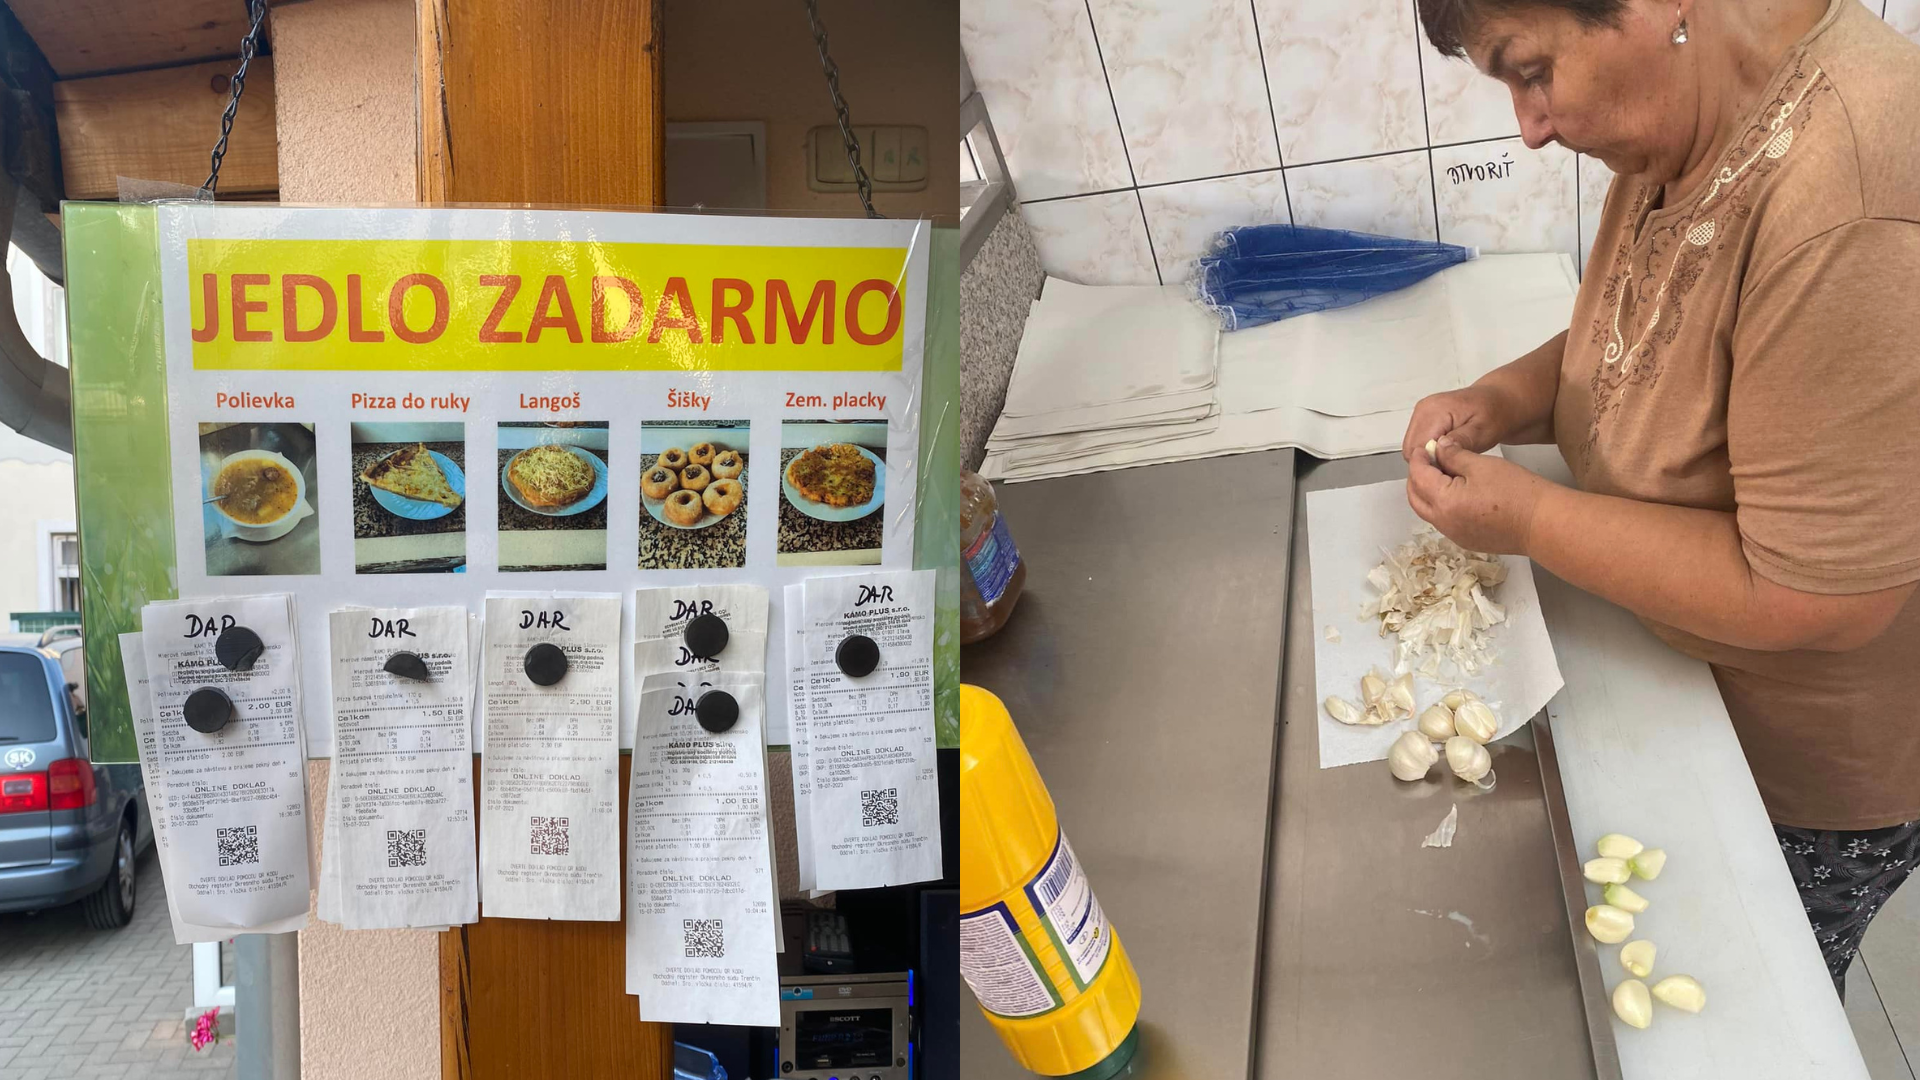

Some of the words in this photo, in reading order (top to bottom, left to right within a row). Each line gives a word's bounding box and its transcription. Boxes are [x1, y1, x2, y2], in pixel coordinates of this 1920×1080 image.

[191, 273, 451, 344] JEDLO
[478, 274, 902, 346] ZADARMO
[216, 391, 295, 410] Polievka
[352, 392, 396, 410] Pizza
[401, 392, 426, 410] do
[430, 392, 470, 413] ruky
[519, 391, 580, 413] Langoš
[666, 389, 711, 413] Šišky
[785, 392, 827, 408] Zem.
[832, 392, 886, 413] placky
[855, 585, 893, 607] DAR
[670, 599, 713, 621] DAR
[184, 614, 236, 637] DAR
[368, 618, 416, 638] DAR
[668, 696, 697, 716] DA
[10, 751, 32, 764] SK
[841, 749, 870, 757] ONLINE
[195, 785, 227, 793] ONLINE
[233, 781, 266, 789] DOKLAD
[368, 787, 399, 795] ONLINE
